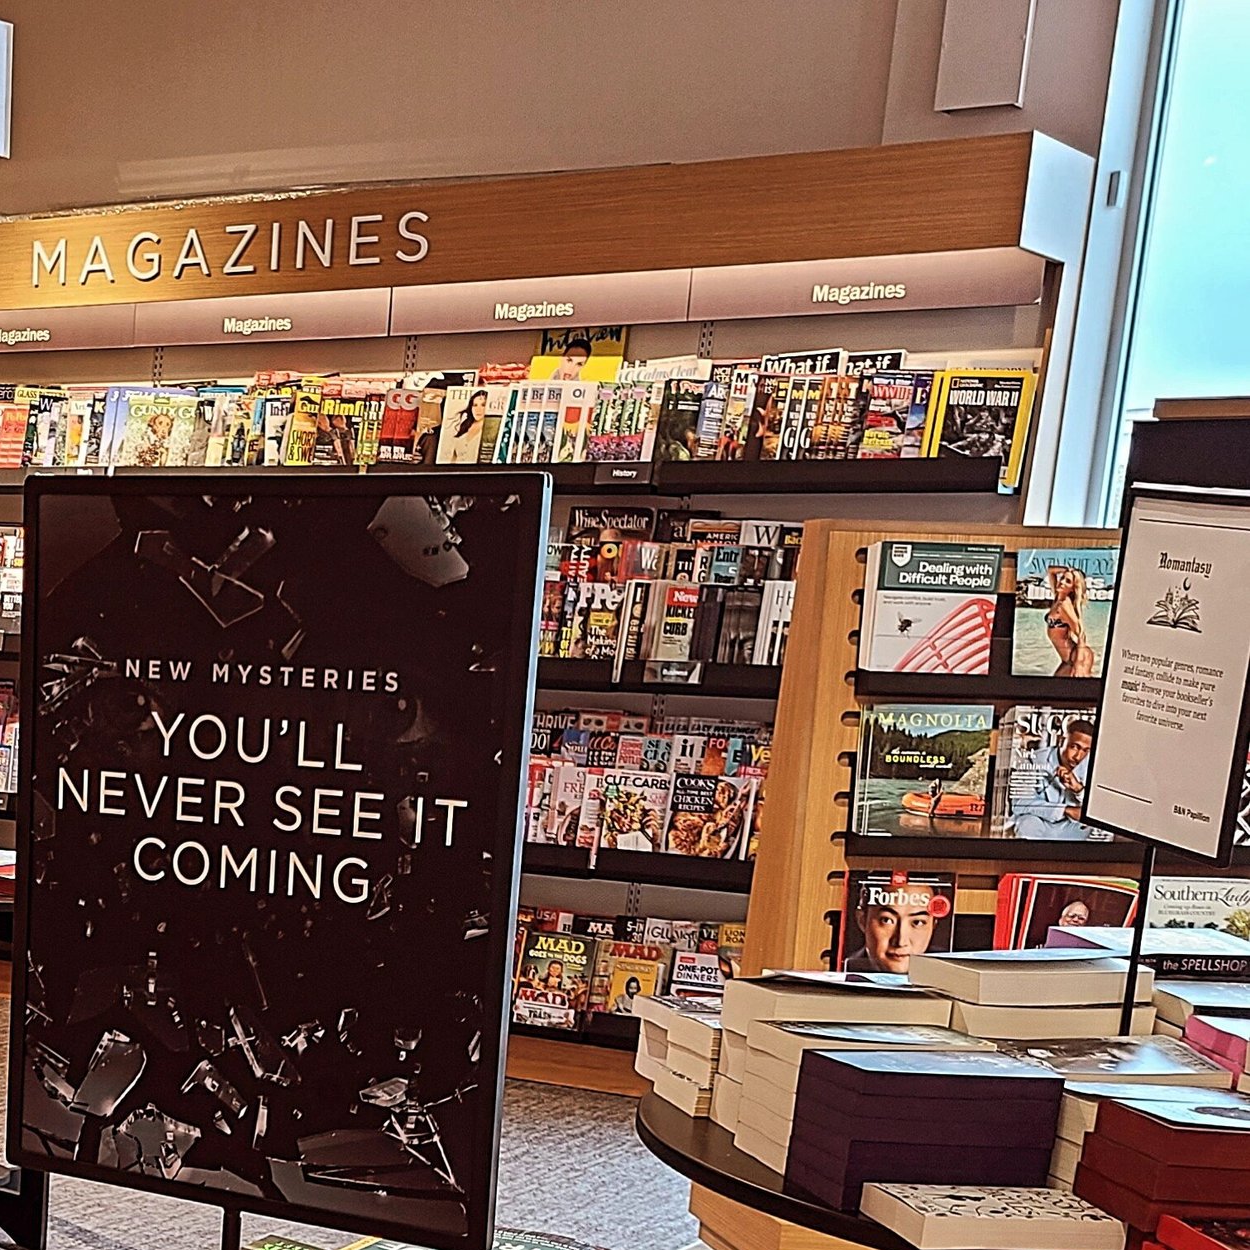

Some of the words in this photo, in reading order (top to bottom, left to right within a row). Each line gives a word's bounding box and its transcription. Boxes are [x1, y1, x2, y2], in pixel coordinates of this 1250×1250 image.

[31, 212, 430, 287] MAGAZINES
[812, 281, 906, 303] Magazines
[494, 300, 575, 321] Magazines
[223, 316, 292, 334] Magazines
[950, 391, 985, 406] WORLD
[987, 390, 1008, 405] WAR
[1010, 390, 1019, 404] II
[574, 509, 600, 529] Wine
[600, 510, 649, 529] Spectator
[919, 561, 964, 576] Dealing
[965, 563, 992, 575] with
[1158, 552, 1212, 578] Romantasy
[899, 572, 947, 584] Difficult
[949, 576, 991, 588] People
[1121, 649, 1140, 661] Where
[1141, 655, 1150, 663] two
[1151, 656, 1173, 669] popular
[1174, 659, 1195, 673] genres,
[1196, 665, 1223, 678] romance
[125, 658, 193, 682] NEW
[212, 663, 400, 693] MYSTERIES
[878, 712, 987, 728] MAGNOLIA
[151, 712, 363, 771] YOU'LL
[885, 754, 945, 765] BOUNDLESS
[57, 767, 246, 826] NEVER
[272, 785, 385, 840] SEE
[414, 796, 468, 846] IT
[673, 794, 714, 806] CHICKEN
[1173, 805, 1186, 816] B&N
[1187, 807, 1210, 822] Papillon
[133, 837, 370, 904] COMING
[867, 886, 930, 907] Forbes
[1154, 884, 1218, 901] Southern
[534, 936, 585, 955] MAD
[677, 963, 719, 975] ONE-POT
[1163, 960, 1179, 970] the
[1180, 959, 1248, 971] SPELLSHOP
[676, 971, 719, 983] DINNERS
